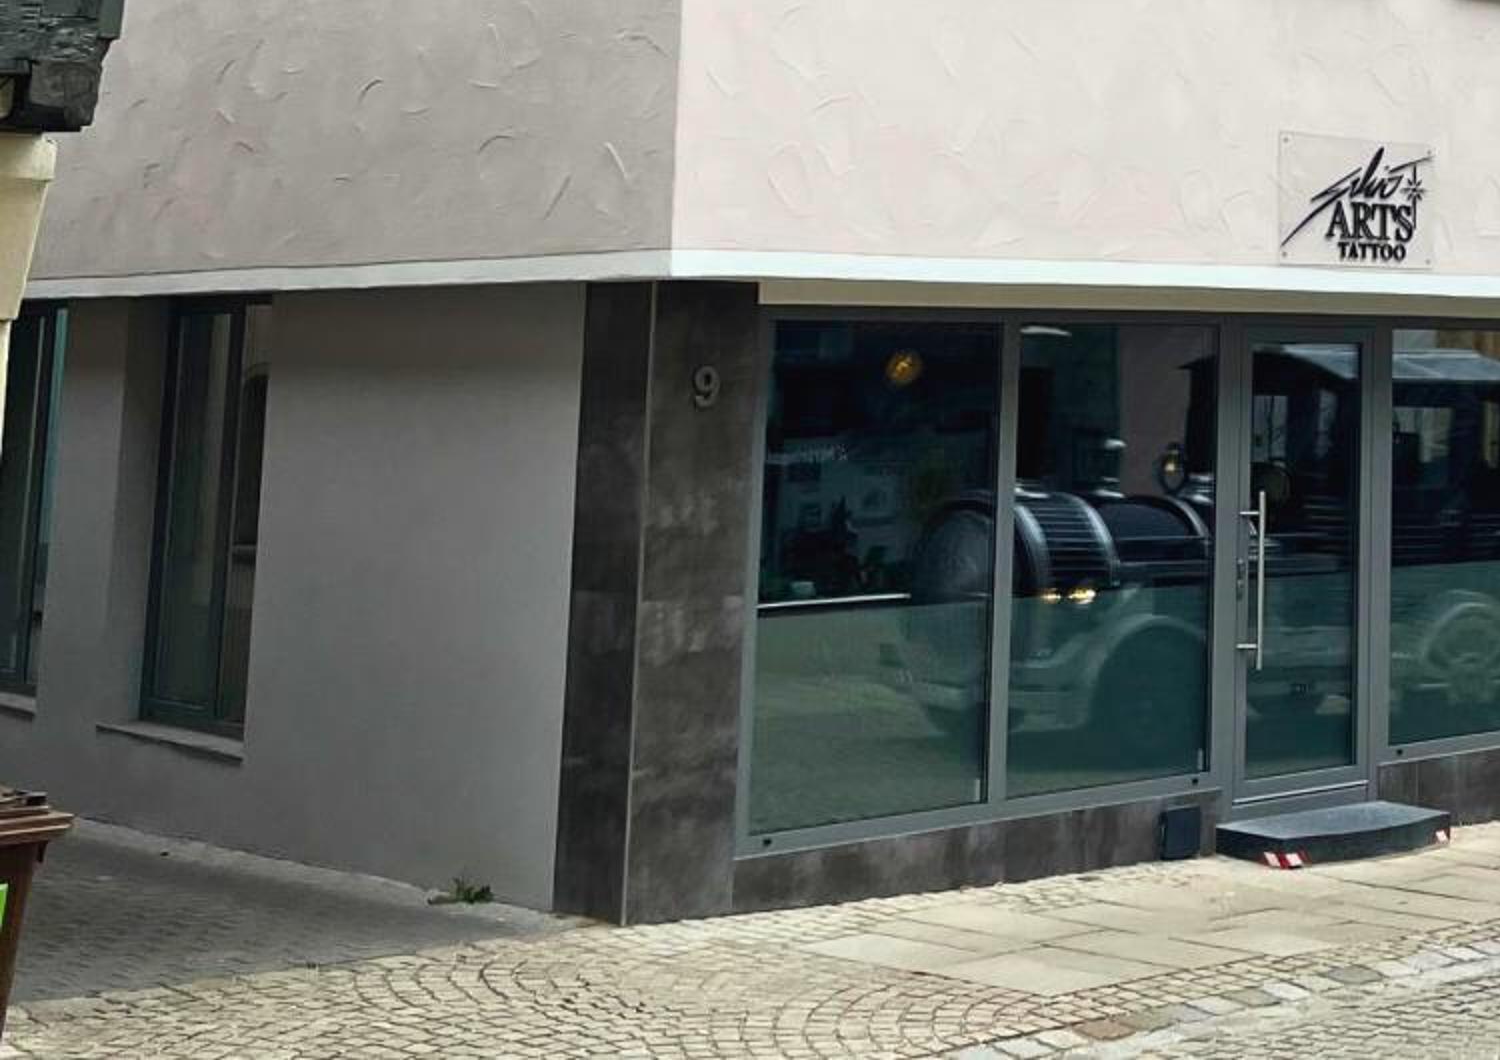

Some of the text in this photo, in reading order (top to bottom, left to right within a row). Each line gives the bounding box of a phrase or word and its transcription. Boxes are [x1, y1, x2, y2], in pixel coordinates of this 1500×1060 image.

[1325, 200, 1414, 243] ARTS
[1337, 241, 1407, 262] TATTOO
[694, 365, 721, 408] 9
